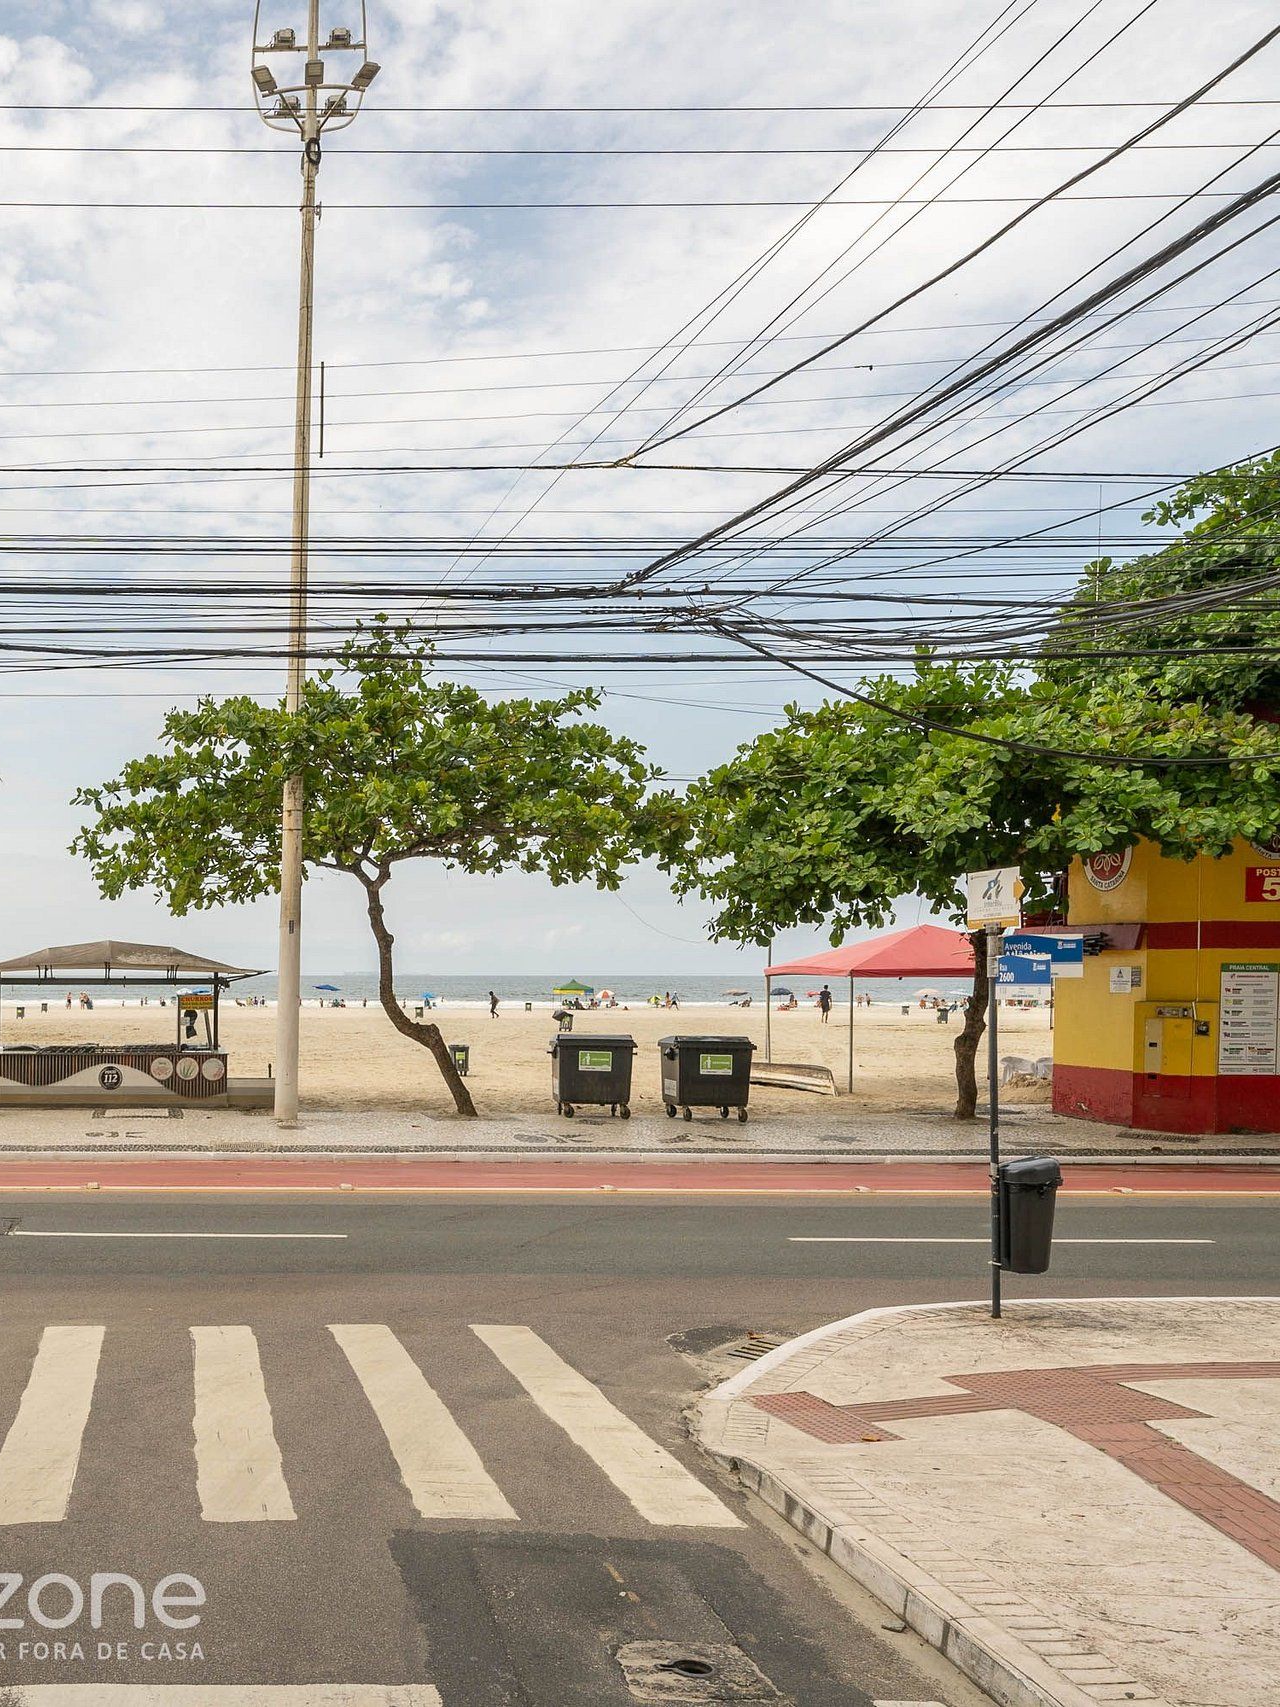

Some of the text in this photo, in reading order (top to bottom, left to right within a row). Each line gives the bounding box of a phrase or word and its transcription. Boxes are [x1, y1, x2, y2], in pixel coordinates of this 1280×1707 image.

[1004, 942, 1032, 951] Avenida
[999, 972, 1014, 982] 2600
[104, 1074, 118, 1083] 112
